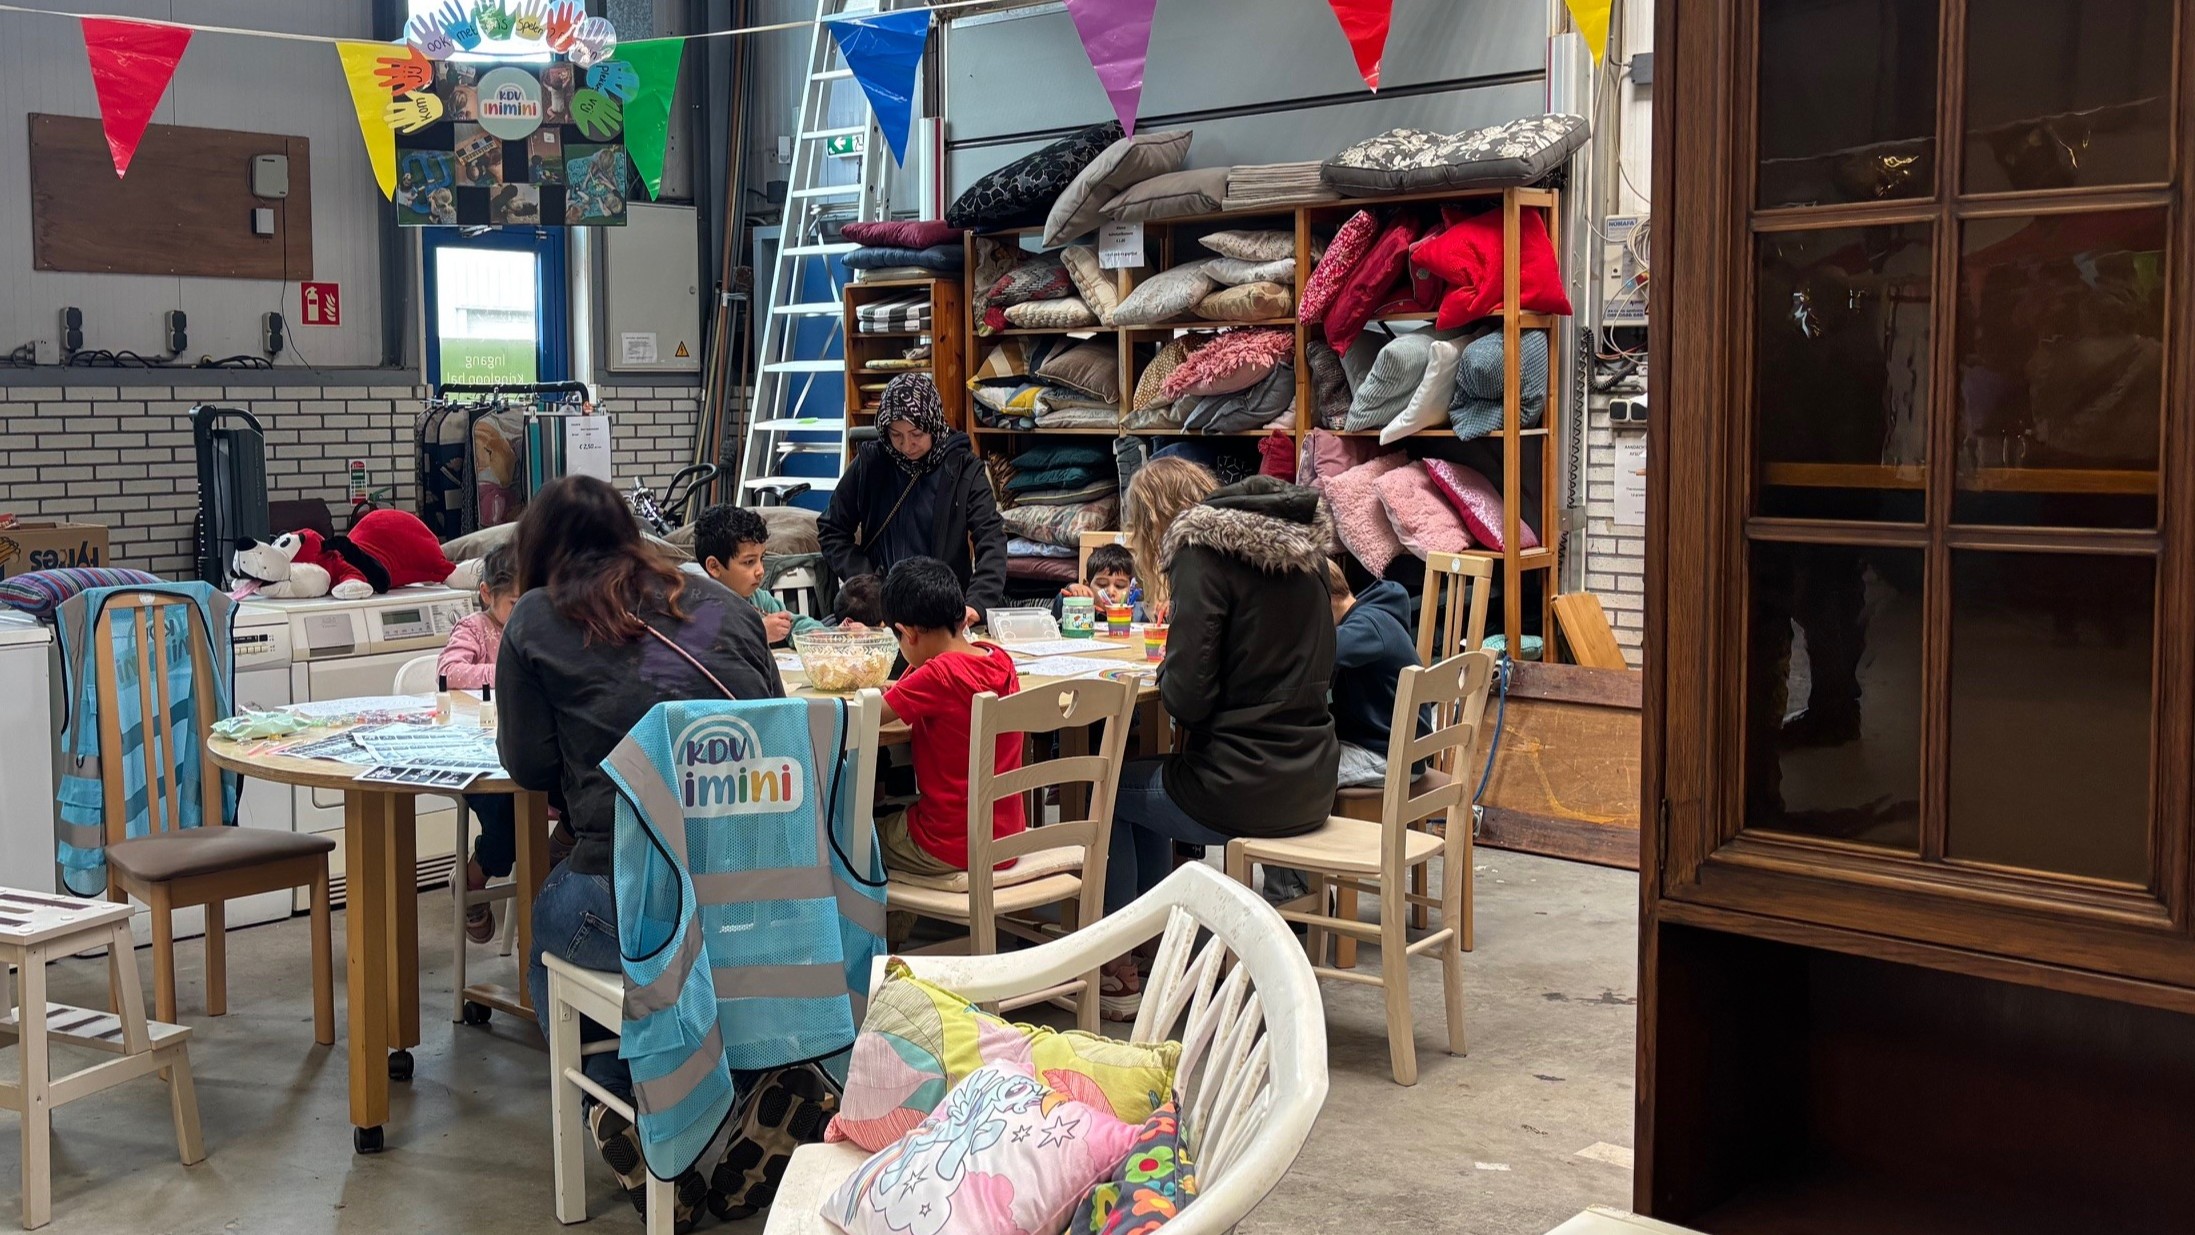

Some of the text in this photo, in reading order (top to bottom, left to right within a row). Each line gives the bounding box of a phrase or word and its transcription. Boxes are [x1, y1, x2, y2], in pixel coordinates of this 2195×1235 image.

[416, 97, 432, 122] Kom
[457, 25, 479, 42] met
[499, 90, 522, 101] KDV
[686, 737, 748, 767] KDV
[685, 763, 792, 808] imini
